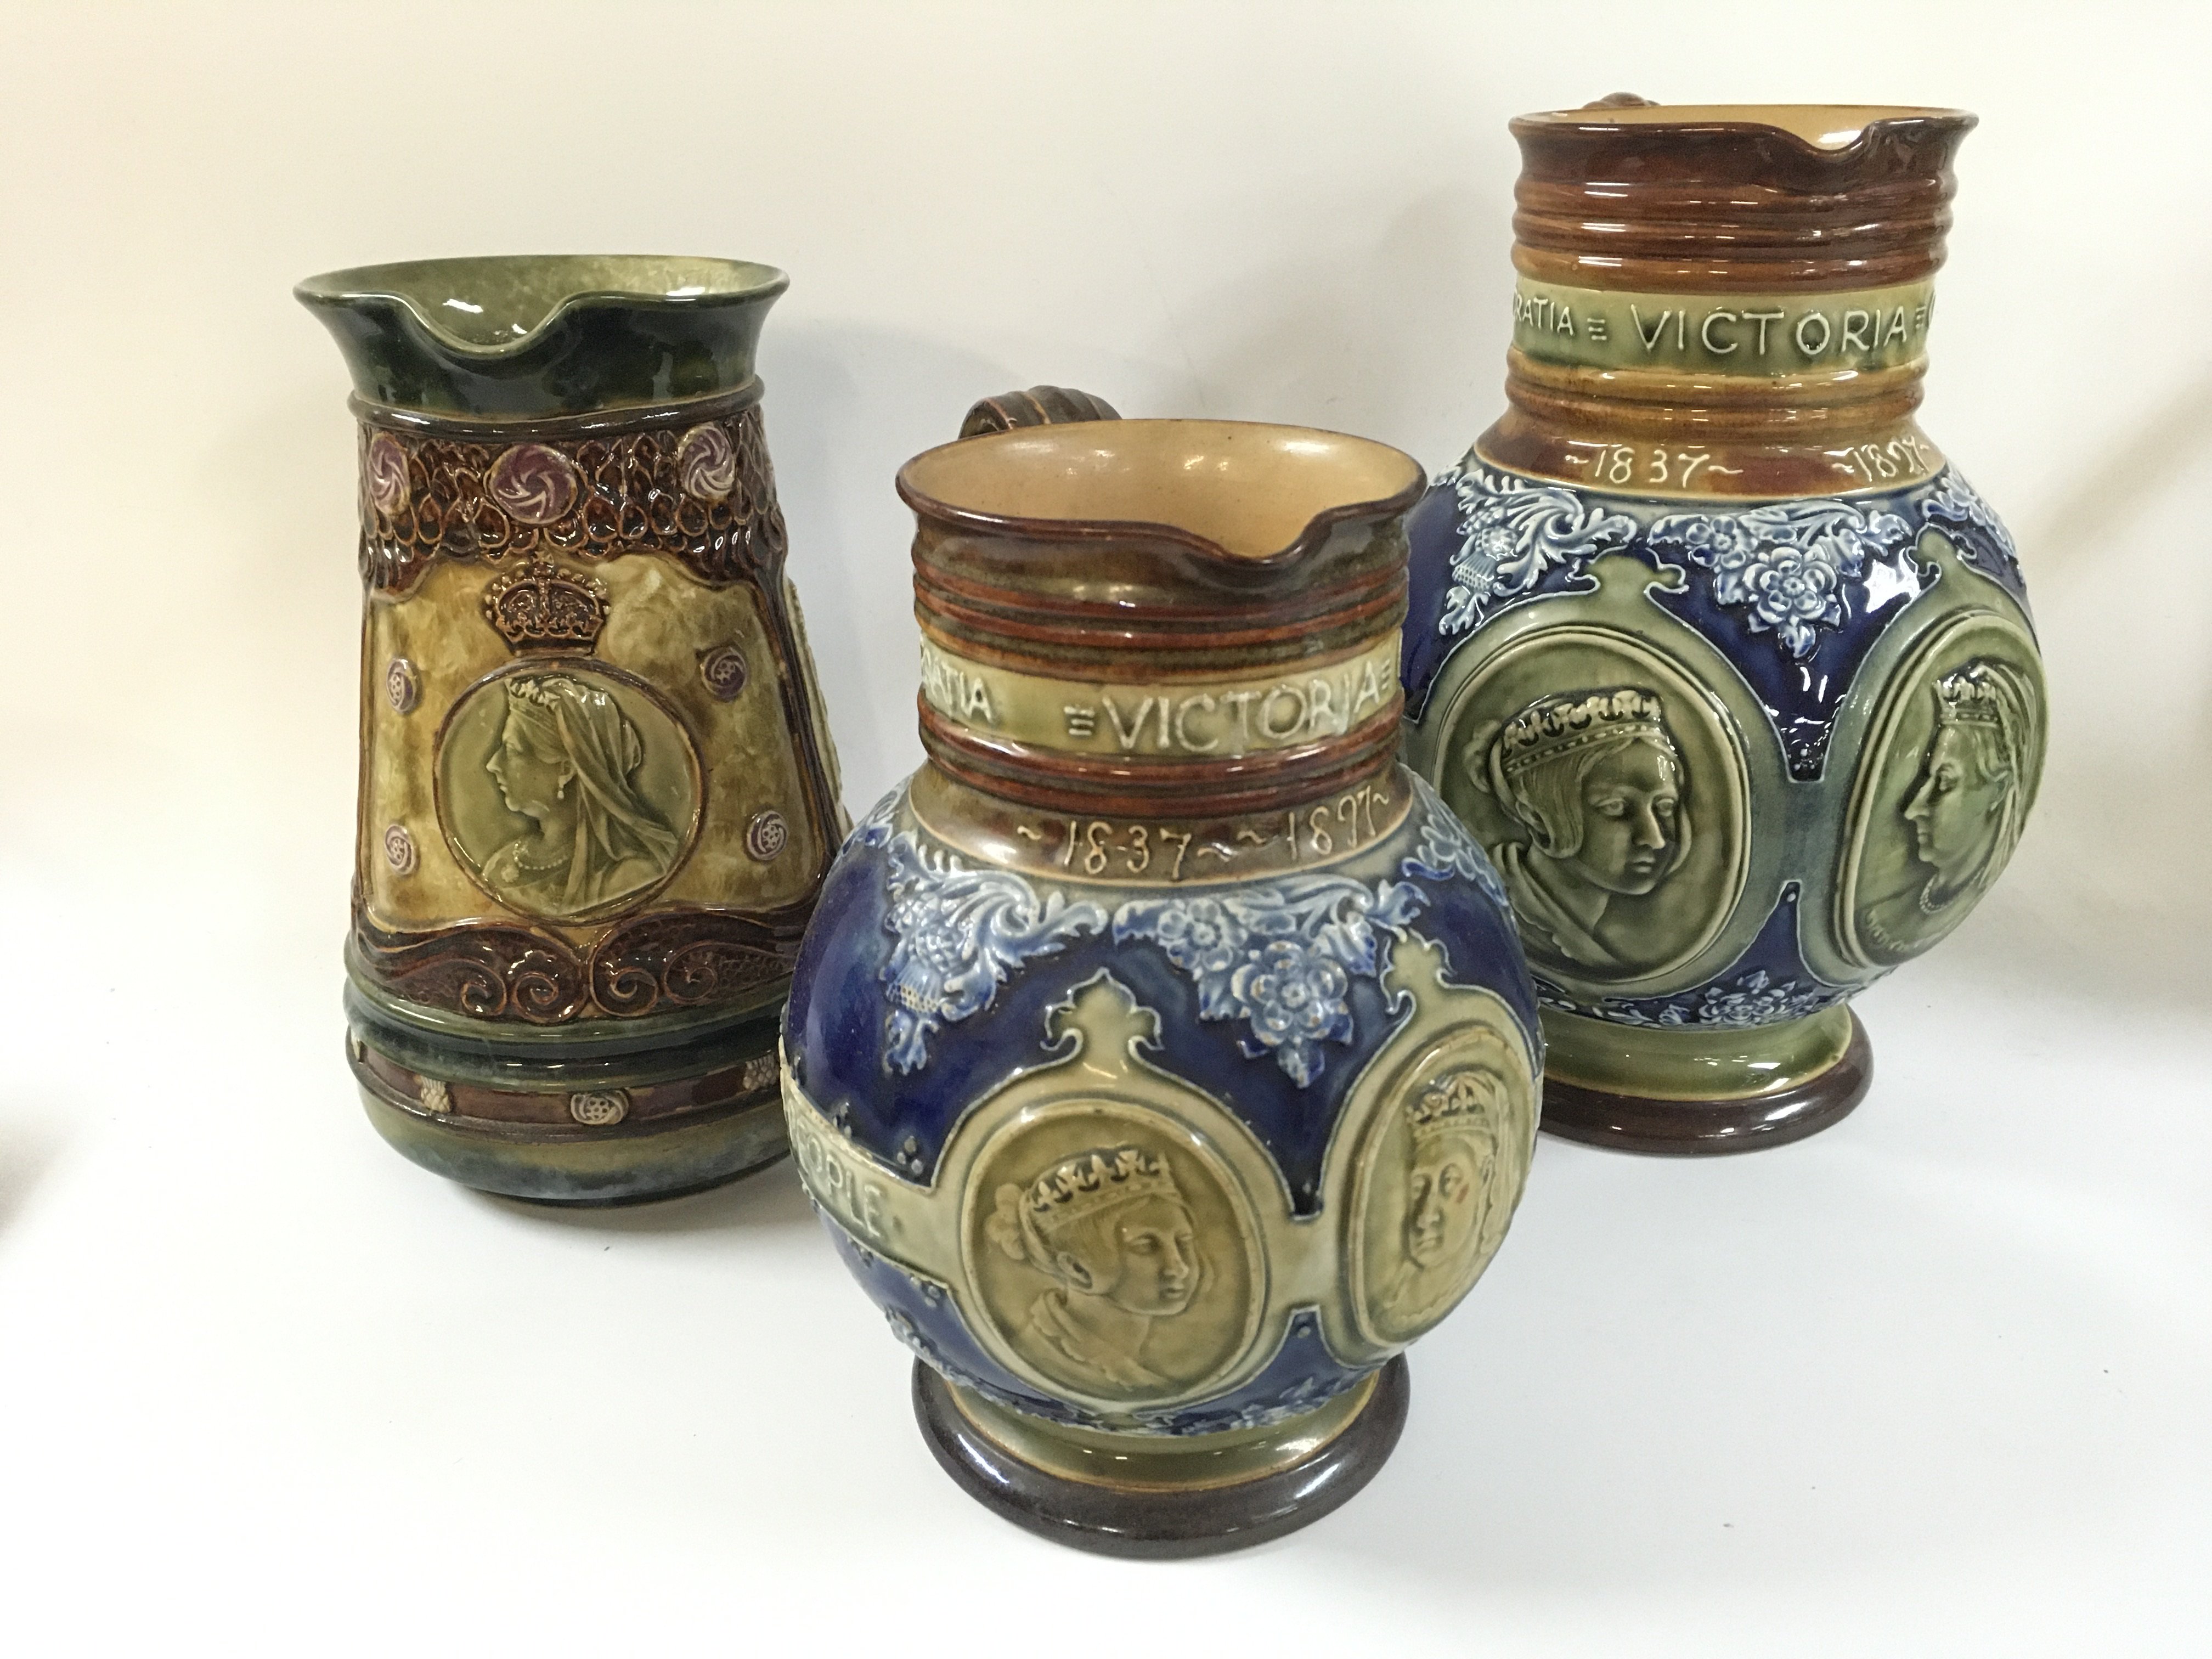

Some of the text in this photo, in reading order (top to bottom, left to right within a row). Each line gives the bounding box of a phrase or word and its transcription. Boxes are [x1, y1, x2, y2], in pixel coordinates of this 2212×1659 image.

[1514, 290, 1575, 336] RATIA
[1630, 303, 1907, 356] VICTORIA
[921, 646, 1380, 753] RATIA VICTORIA
